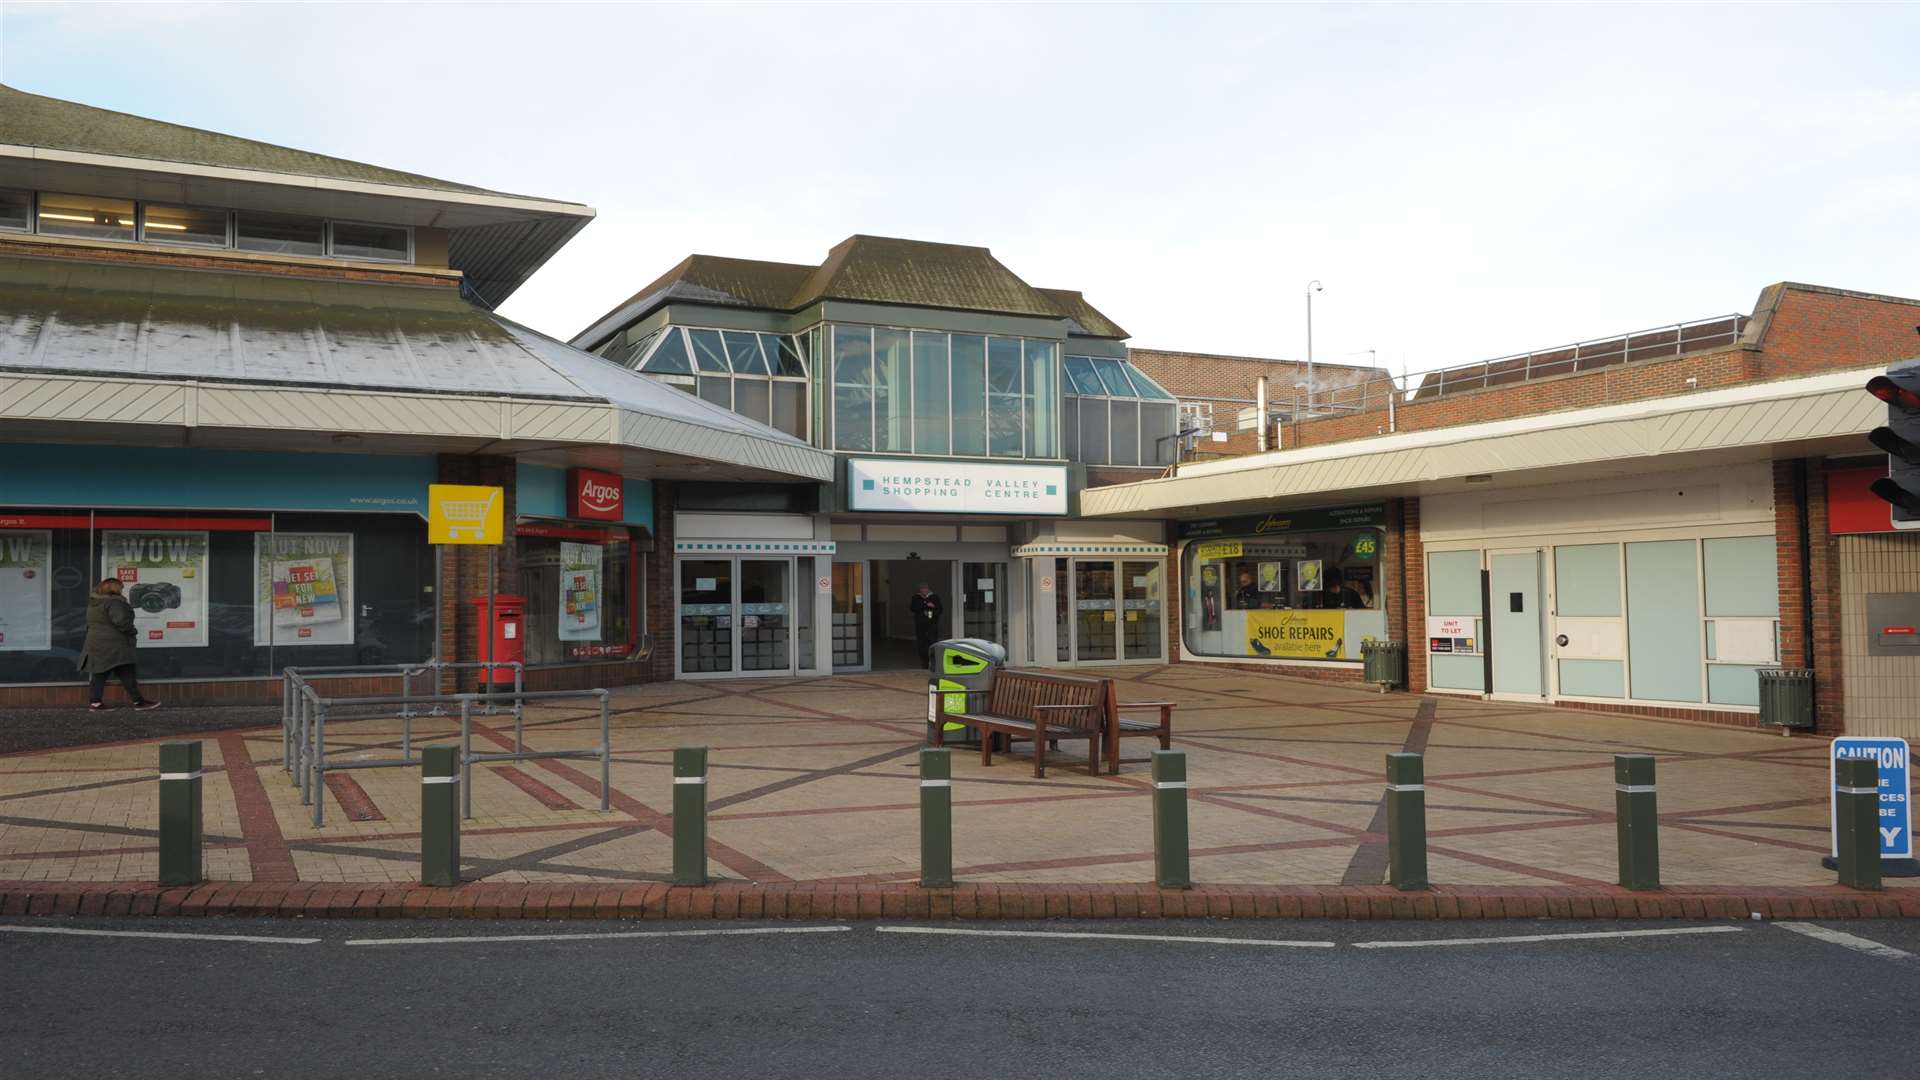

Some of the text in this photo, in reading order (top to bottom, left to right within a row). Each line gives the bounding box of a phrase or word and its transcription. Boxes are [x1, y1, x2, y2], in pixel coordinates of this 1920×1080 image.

[883, 477, 1039, 488] HEMPSTEAD VALLEY
[582, 479, 620, 503] Argos
[883, 487, 1040, 499] SHOPPING CENTRE
[122, 538, 190, 562] WOW
[304, 539, 338, 554] NOW
[1258, 626, 1334, 641] SHOE REPAIRS
[1879, 793, 1905, 802] CES
[1879, 826, 1902, 847] Y
